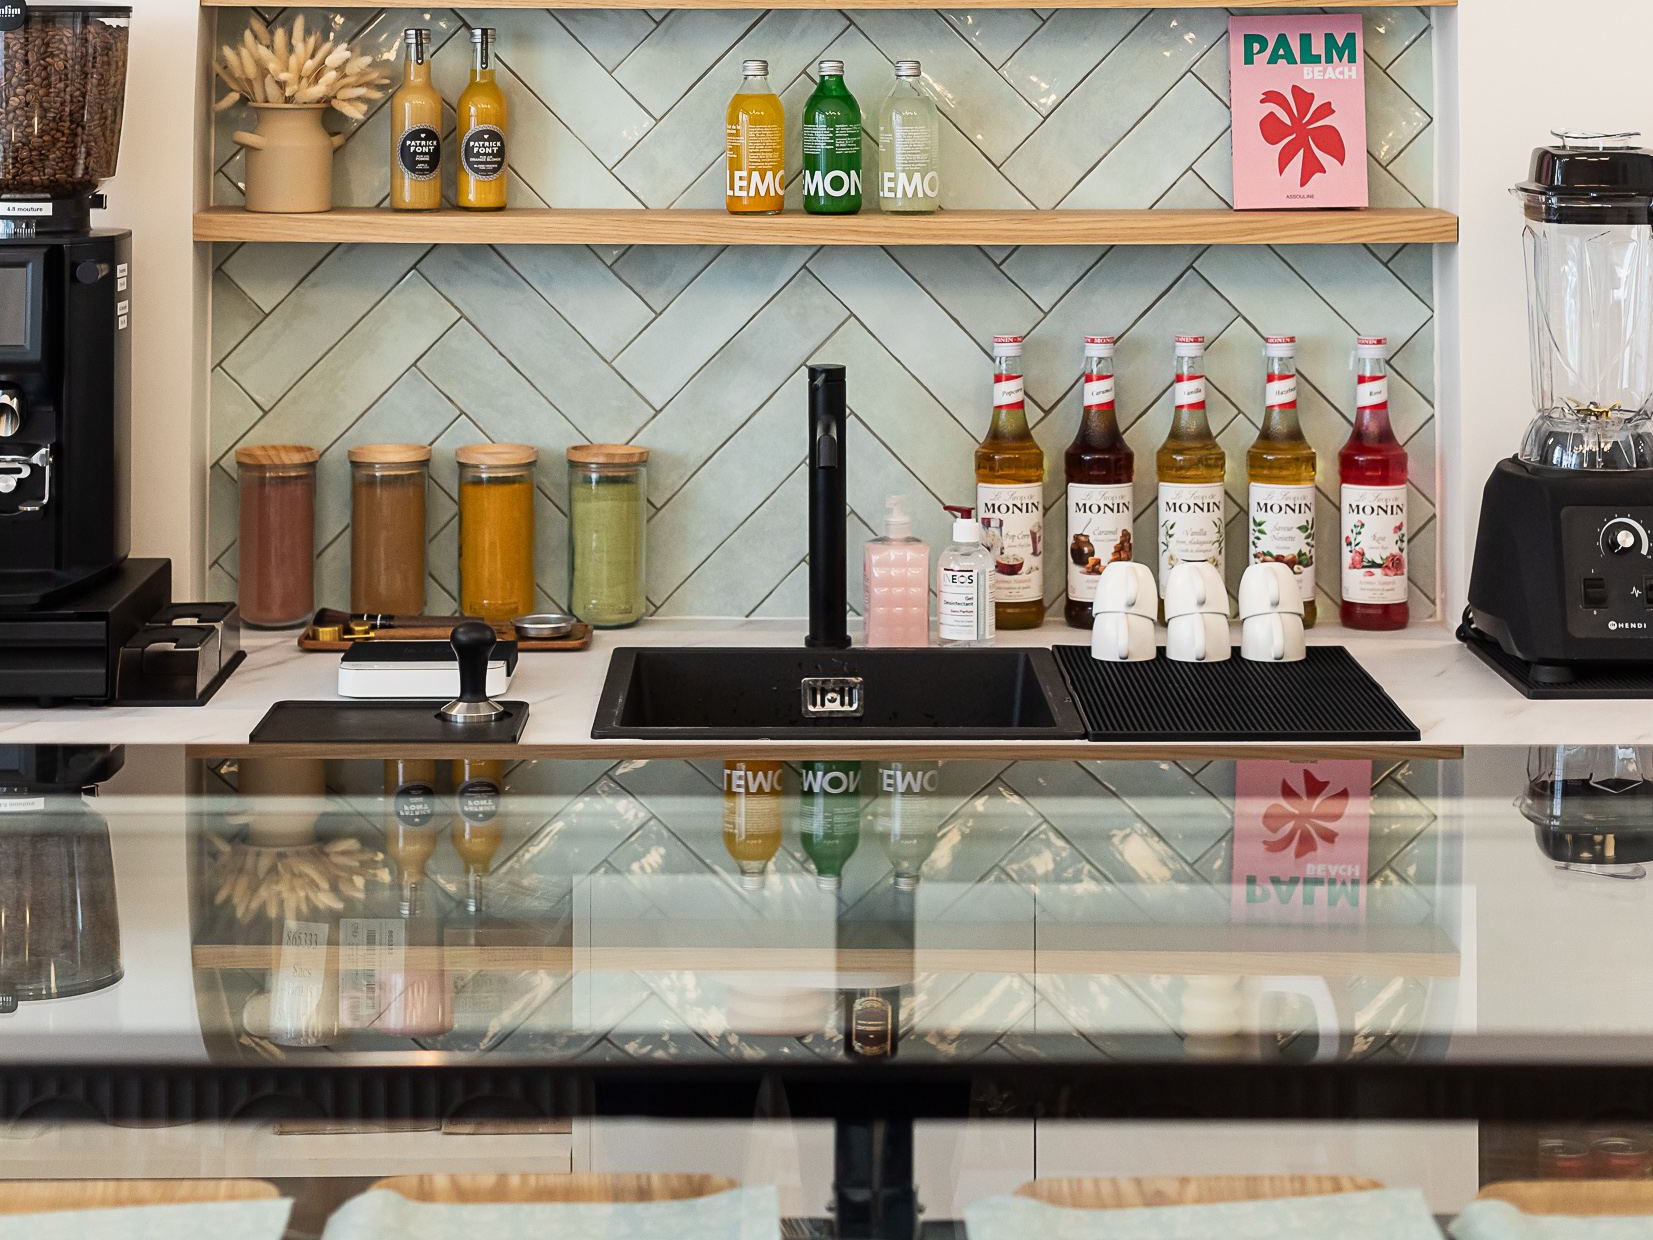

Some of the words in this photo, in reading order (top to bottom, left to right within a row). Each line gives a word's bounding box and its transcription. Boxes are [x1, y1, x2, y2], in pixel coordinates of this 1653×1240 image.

[1243, 32, 1357, 65] PALM
[1303, 66, 1357, 80] BEACH
[803, 169, 863, 197] MON
[984, 501, 1040, 515] MONIN
[1074, 501, 1130, 515] MONIN
[1165, 500, 1221, 513] MONIN
[1256, 501, 1312, 515] MONIN
[1348, 503, 1404, 516] MONIN
[943, 574, 974, 584] INEOS
